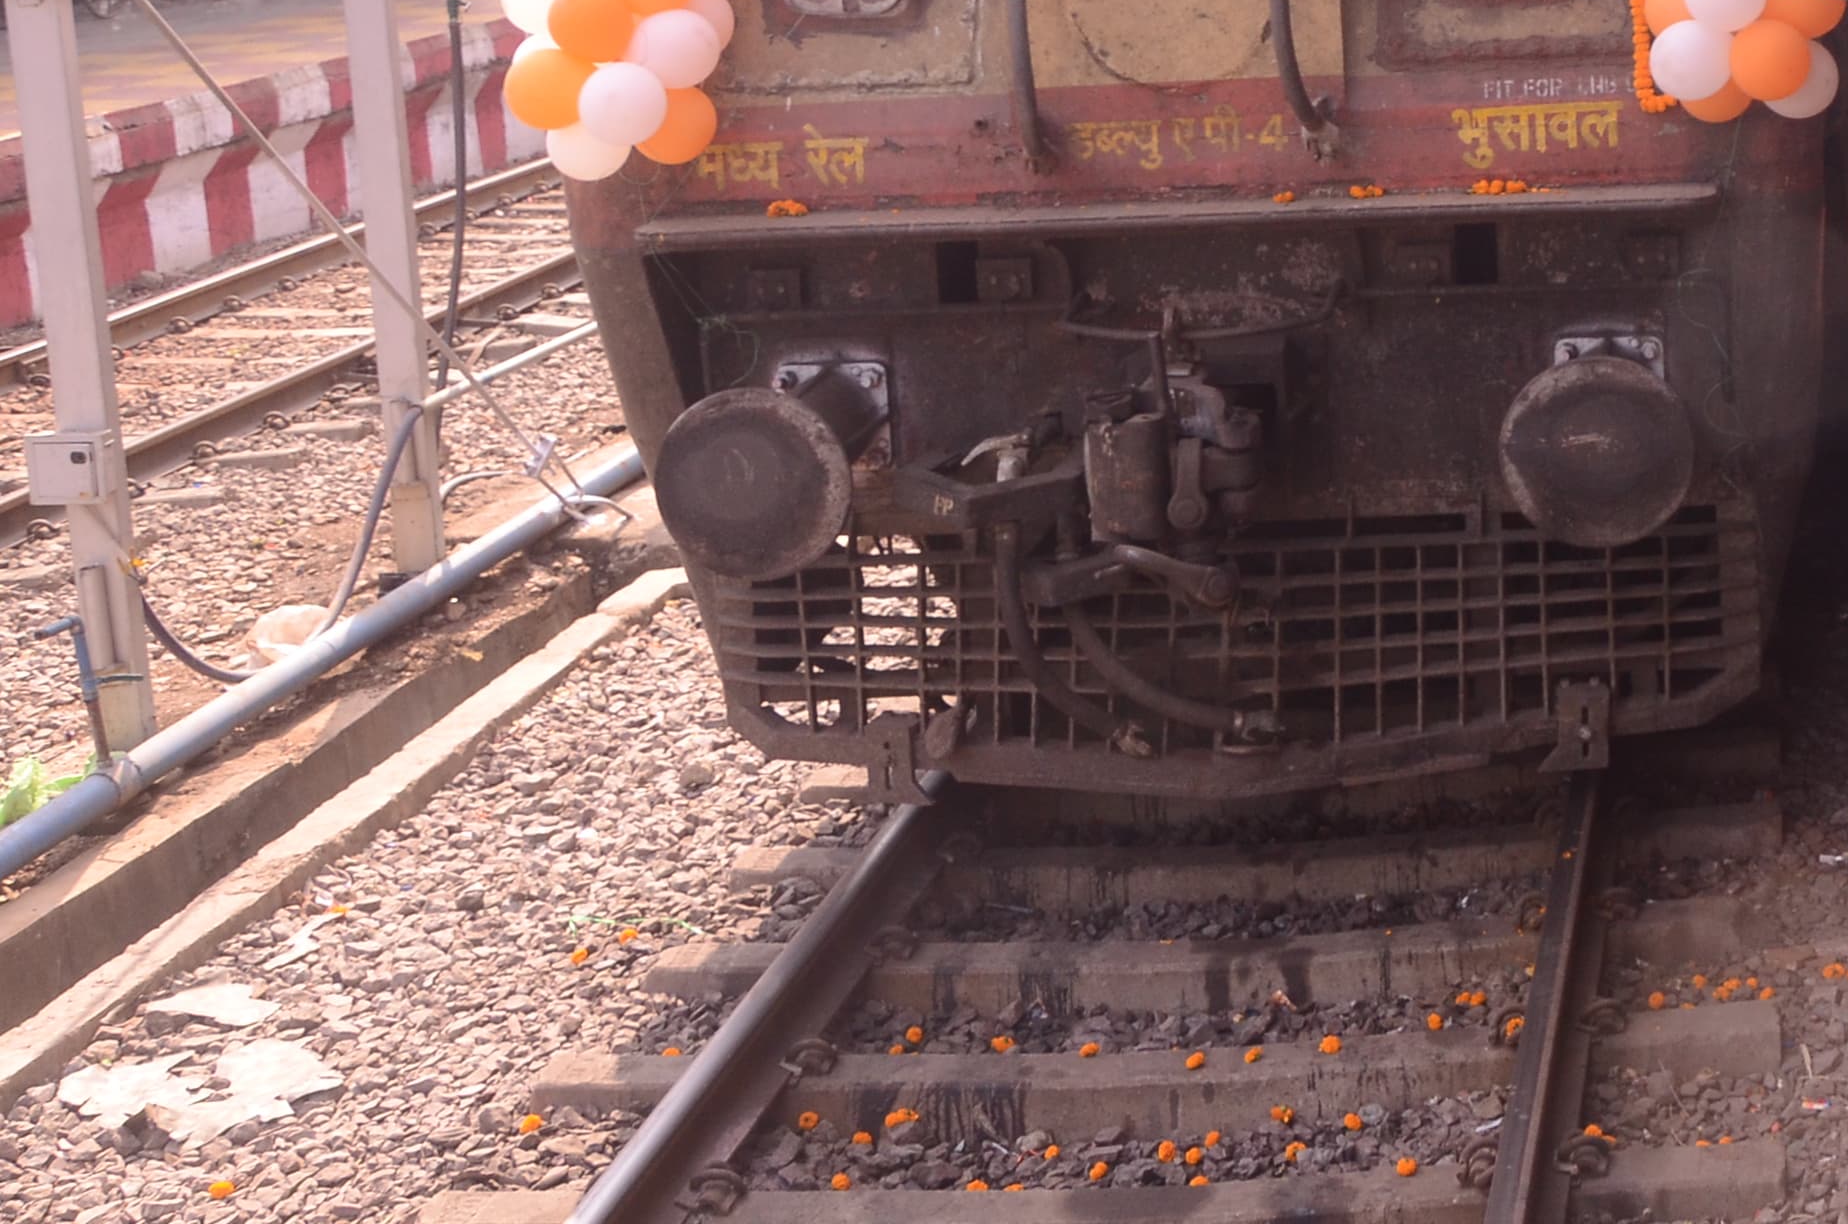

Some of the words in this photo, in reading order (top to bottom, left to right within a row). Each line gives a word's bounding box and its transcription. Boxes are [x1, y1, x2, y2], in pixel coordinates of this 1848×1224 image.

[1484, 79, 1514, 99] FIT
[1523, 78, 1563, 97] FOR
[698, 141, 783, 191] मध्य
[803, 122, 870, 184] रेल
[1452, 100, 1624, 169] भुसावल
